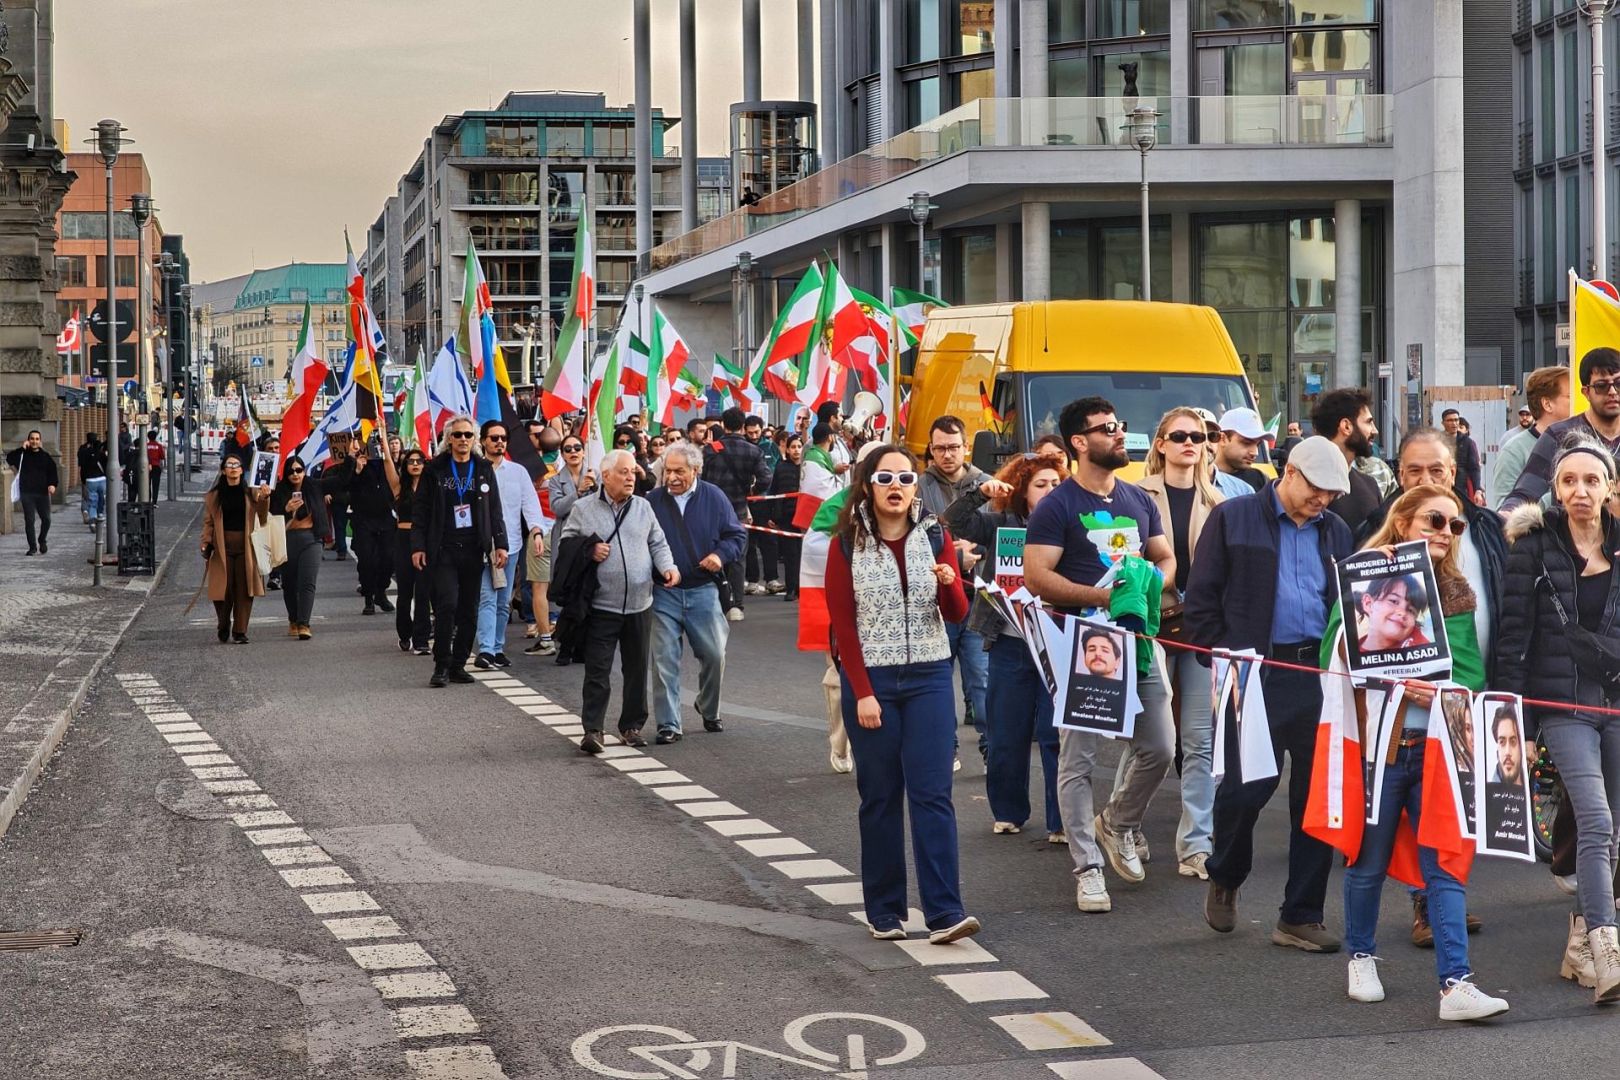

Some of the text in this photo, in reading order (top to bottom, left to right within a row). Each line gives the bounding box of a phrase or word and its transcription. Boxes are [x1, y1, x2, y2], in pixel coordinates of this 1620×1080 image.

[1000, 536, 1023, 548] weg
[1346, 559, 1386, 570] MURDERED
[1397, 553, 1422, 562] ISLAMIC
[1360, 566, 1389, 577] REGIME
[1399, 562, 1415, 571] IRAN
[1361, 646, 1439, 666] MELINA ASADI
